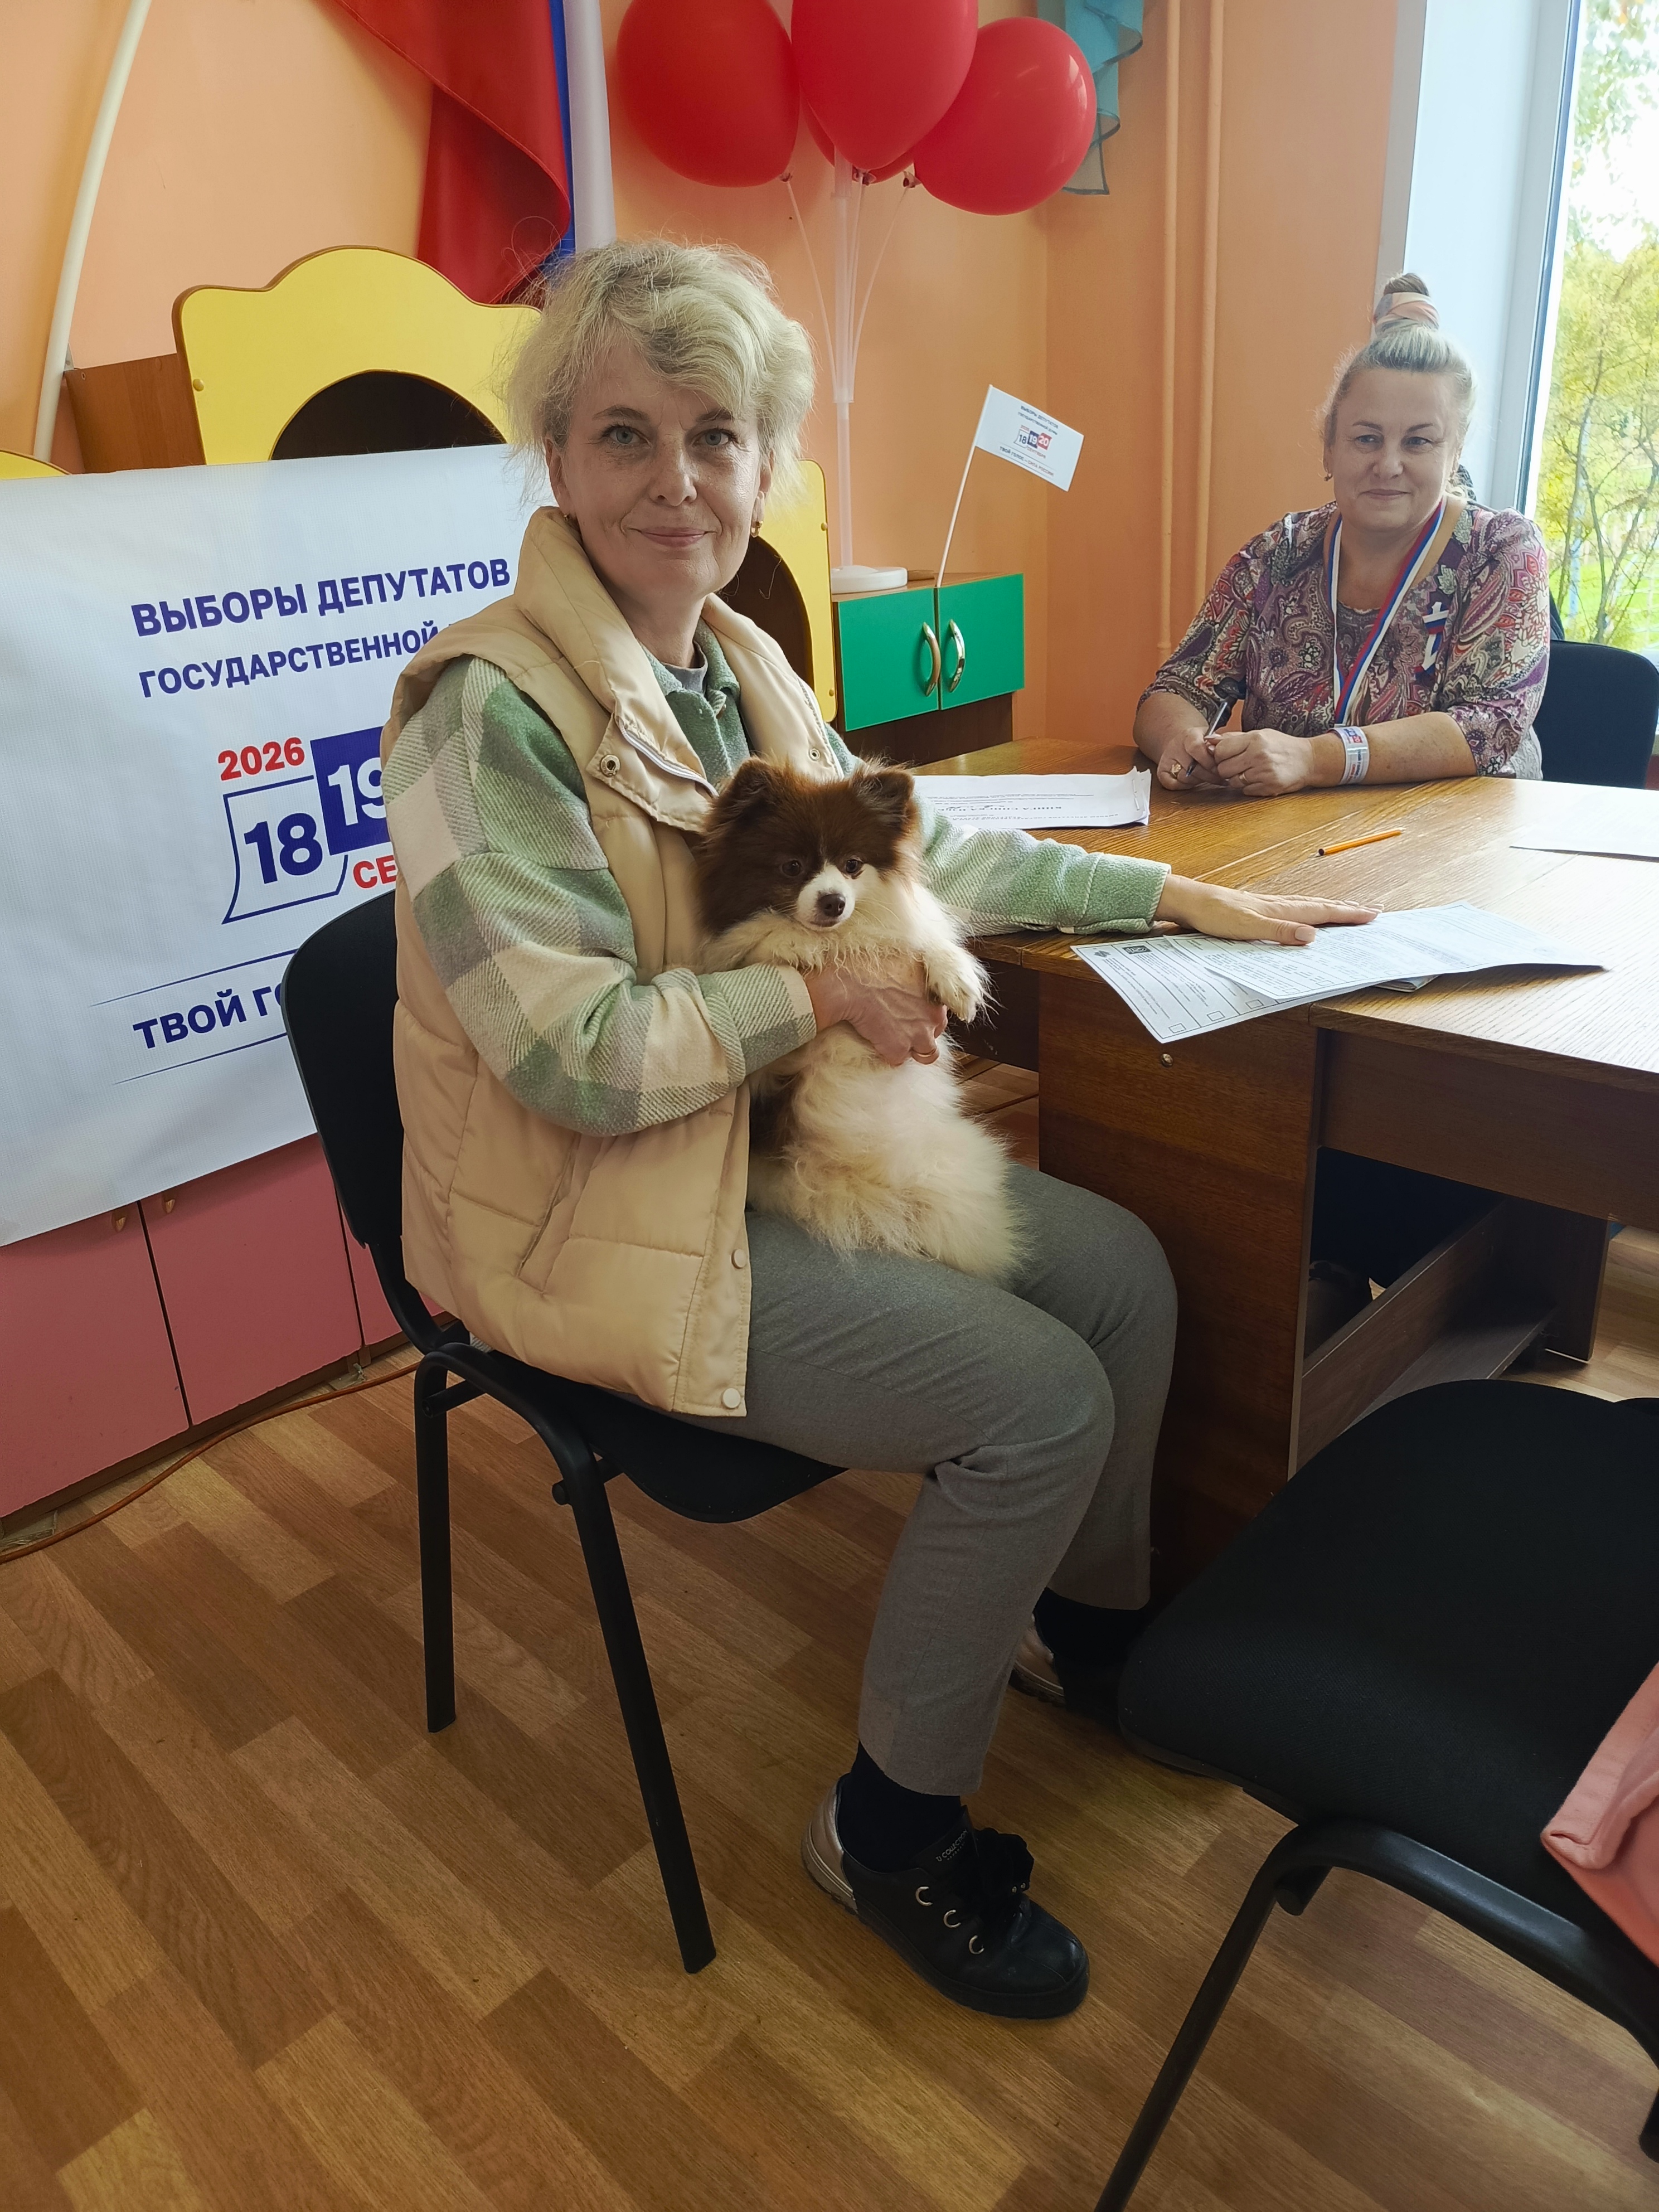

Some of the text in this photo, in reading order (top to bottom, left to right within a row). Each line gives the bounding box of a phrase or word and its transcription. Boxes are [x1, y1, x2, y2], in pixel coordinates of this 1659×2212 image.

[1019, 434, 1049, 447] 18 19 20
[131, 558, 511, 637] ВЫБОРЫ ДЕПУТАТОВ
[139, 620, 438, 697] ГОСУДАРСТВЕННОЙ
[218, 737, 305, 780] 2026
[244, 757, 387, 884] 18 19
[133, 983, 282, 1049] ТВОЙ Г
